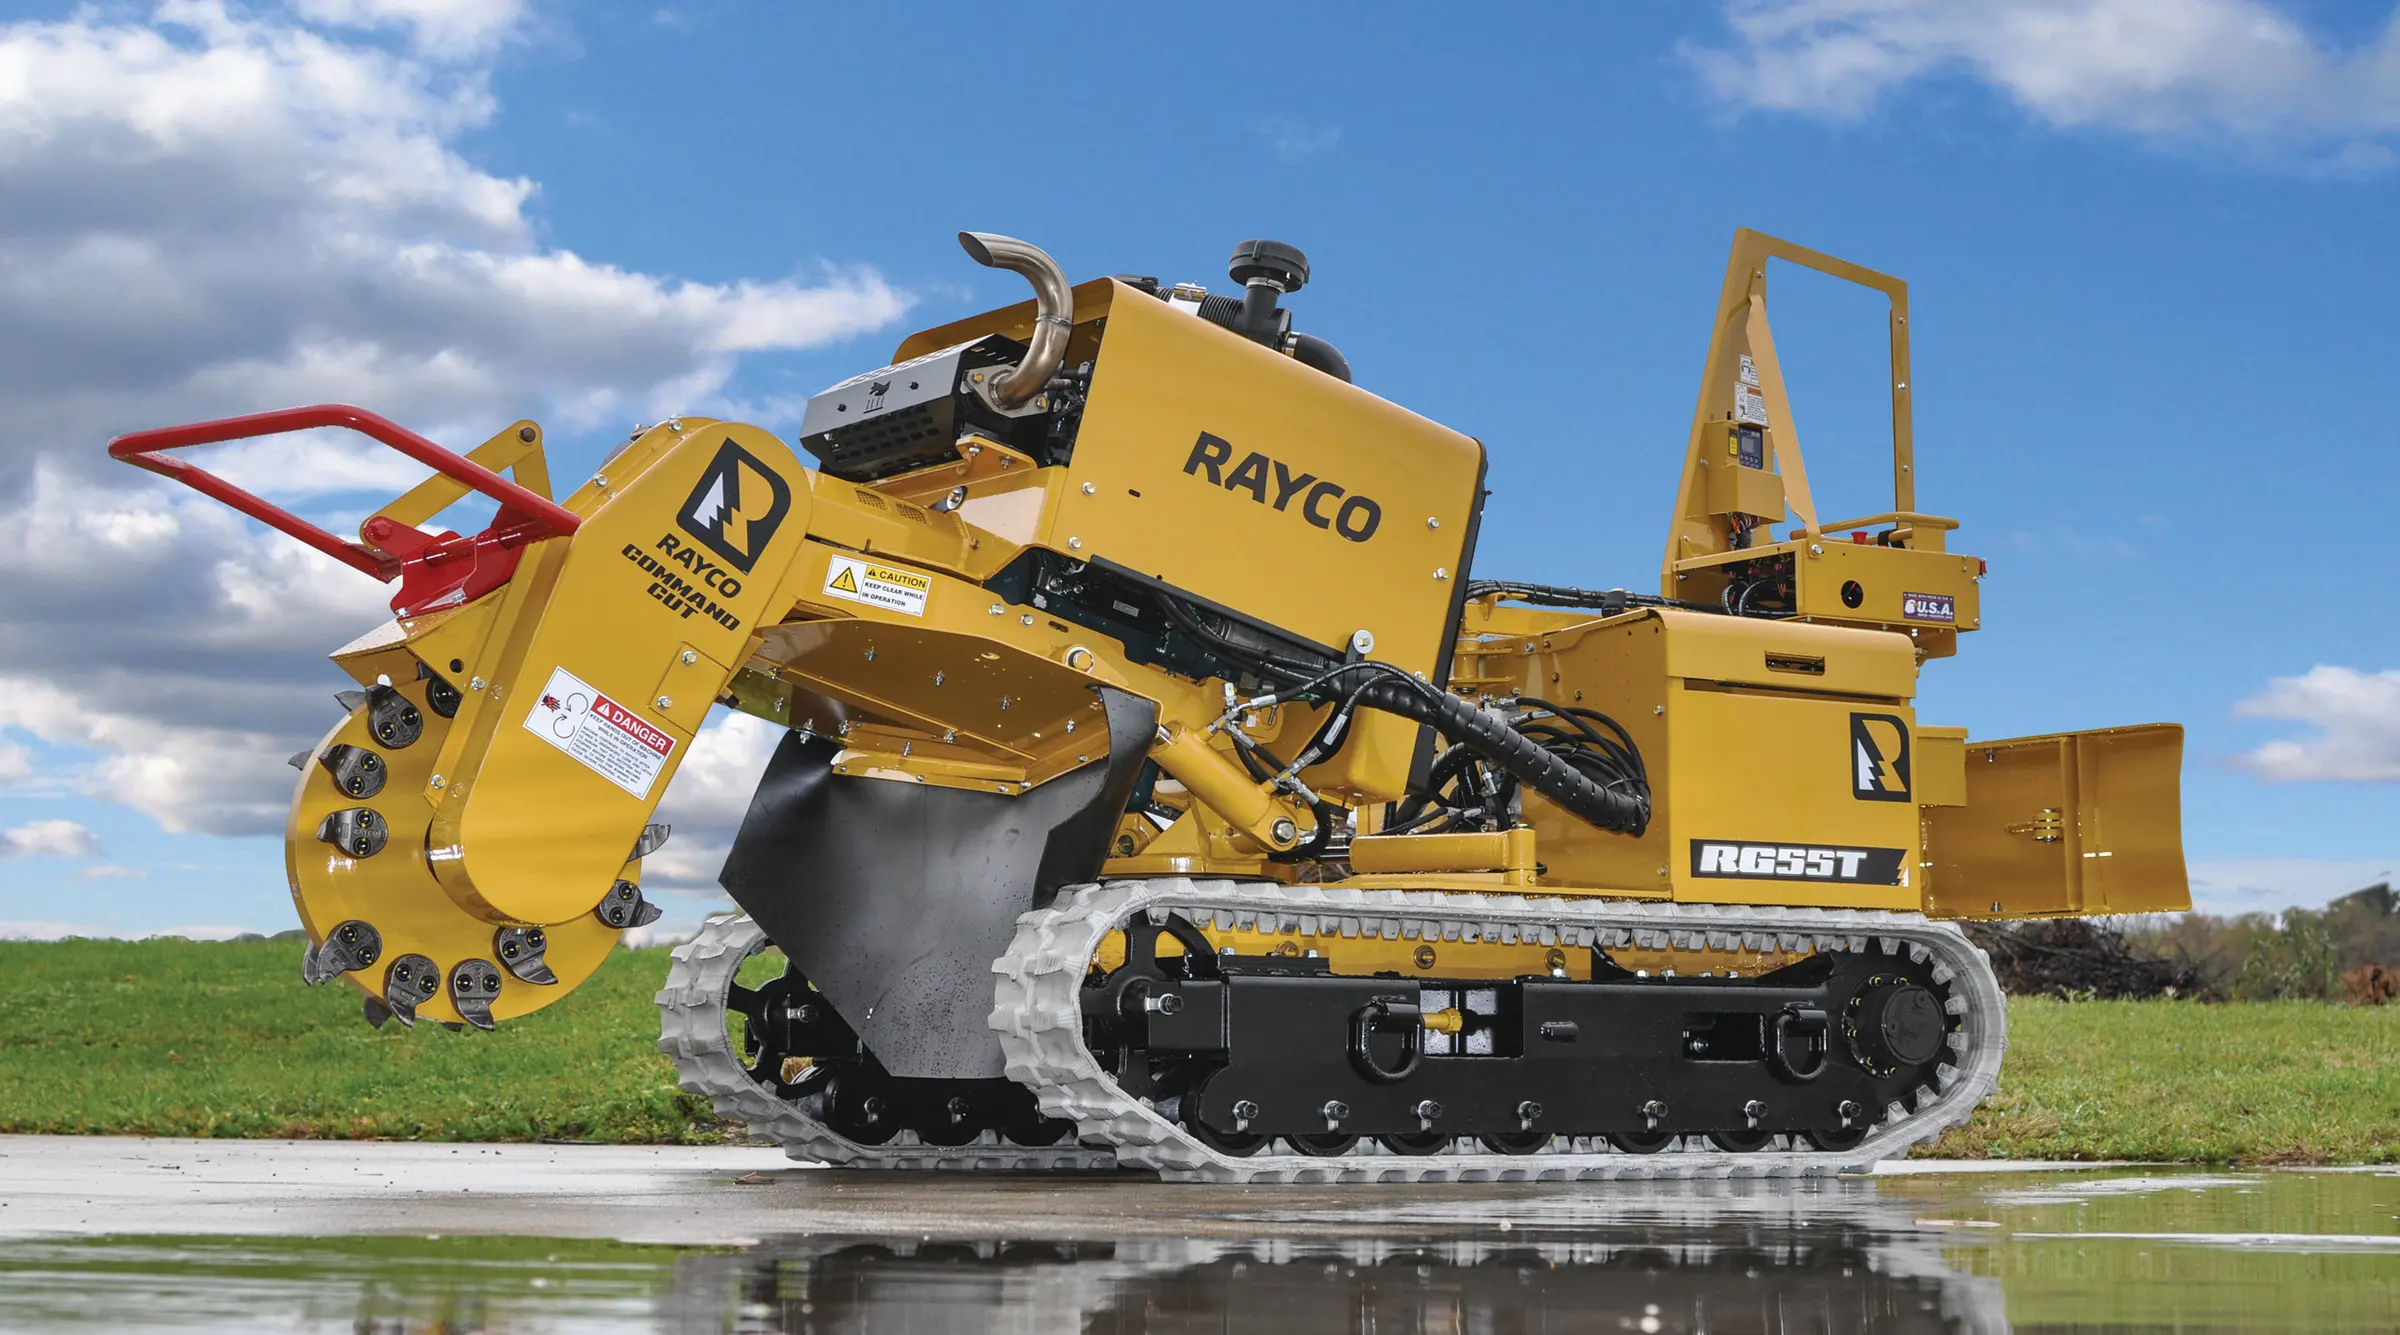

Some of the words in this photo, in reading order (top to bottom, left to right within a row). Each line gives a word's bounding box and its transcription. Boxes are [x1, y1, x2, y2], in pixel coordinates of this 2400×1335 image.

[1183, 430, 1382, 543] RAYCO
[656, 532, 742, 598] RAYCO
[879, 570, 927, 588] CAUTION
[621, 543, 740, 631] COMMAND
[647, 582, 699, 619] CUT
[865, 581, 882, 590] KEEP
[882, 586, 903, 595] CLEAR
[904, 590, 923, 600] WHILE
[870, 594, 906, 606] OPERATION
[1917, 600, 1953, 615] U.S.A.
[590, 714, 604, 724] KEEP
[603, 722, 621, 735] HANDS
[621, 734, 631, 742] OUT
[639, 745, 662, 760] MACHINE
[597, 726, 613, 738] WHILE
[619, 740, 648, 759] OPERATION
[612, 710, 667, 751] DANGER
[1700, 844, 1867, 878] RG55T
